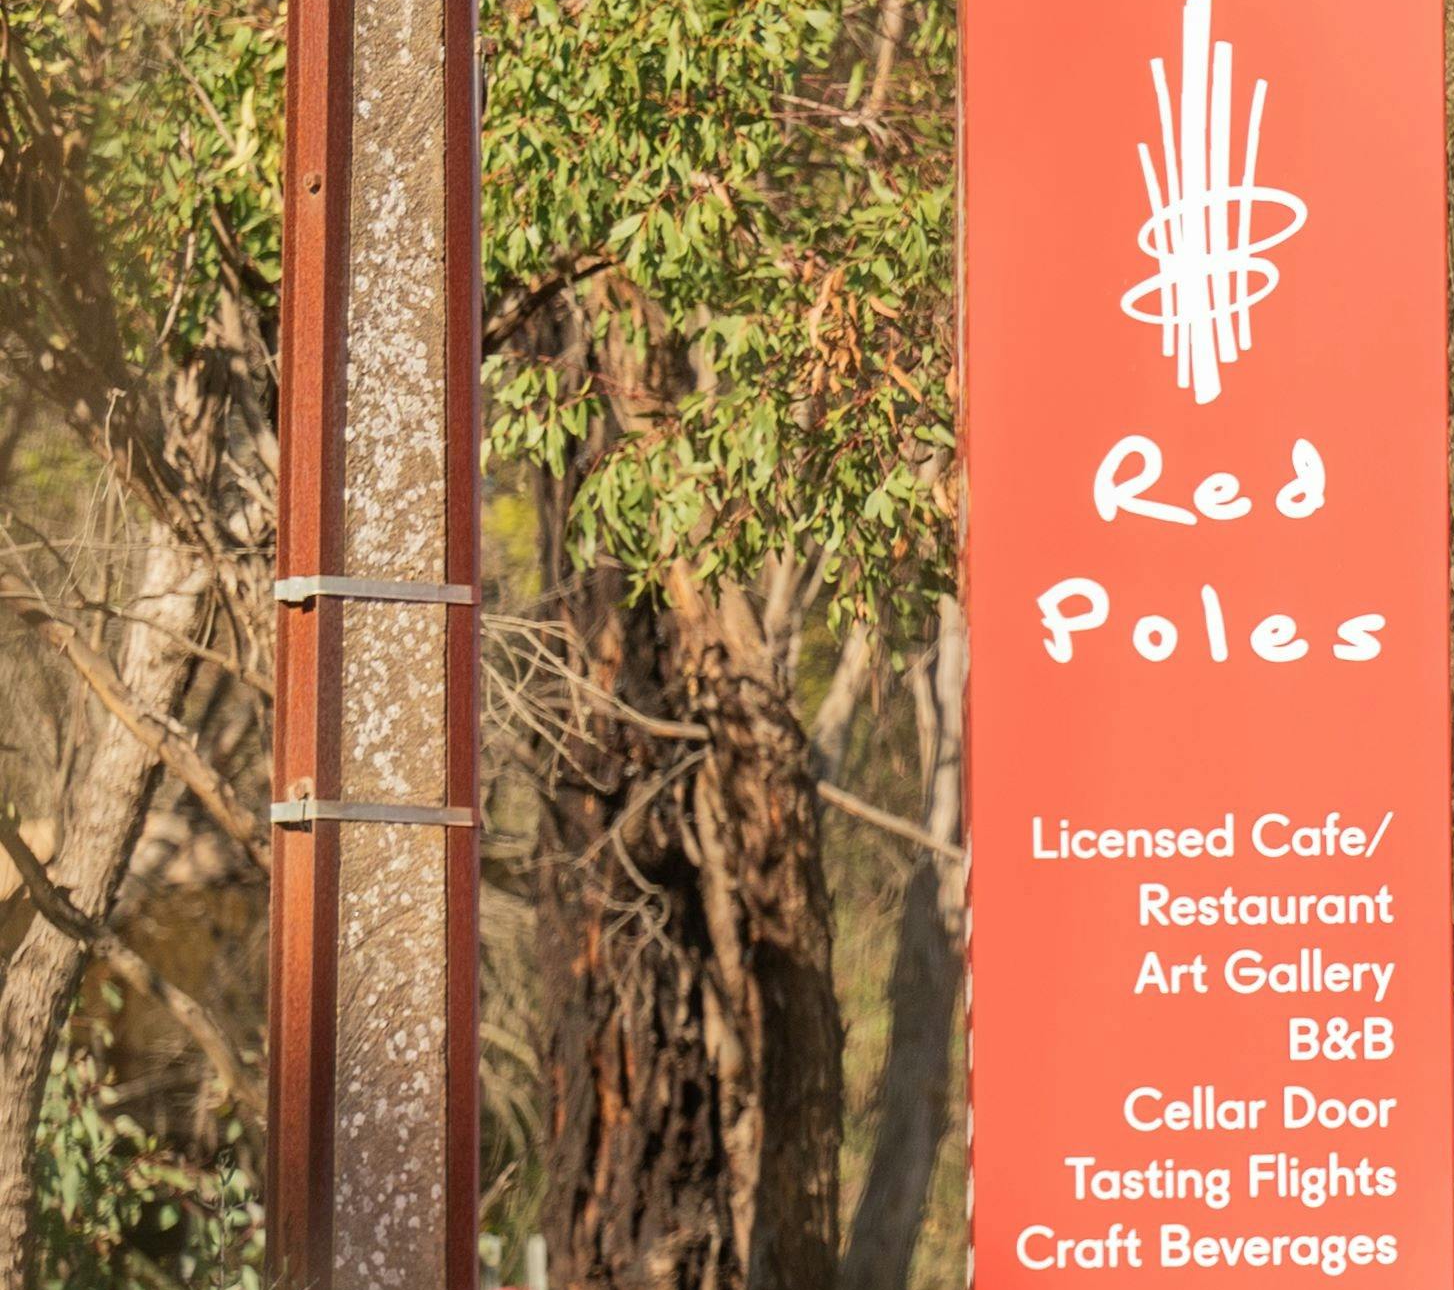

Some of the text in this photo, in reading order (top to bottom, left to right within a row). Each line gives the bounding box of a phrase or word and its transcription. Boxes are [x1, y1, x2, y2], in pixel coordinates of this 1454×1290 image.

[1094, 435, 1325, 525] Red
[1037, 578, 1385, 663] Poles
[1033, 812, 1393, 858] Licensed Cafe/
[1140, 883, 1393, 925] Restaurant
[1134, 948, 1394, 1002] Art Gallery
[1290, 1017, 1394, 1060] B&B
[1124, 1086, 1396, 1131] Cellar Door
[1065, 1152, 1397, 1209] Tasting Flights
[1017, 1224, 1397, 1276] Craft Beverages
